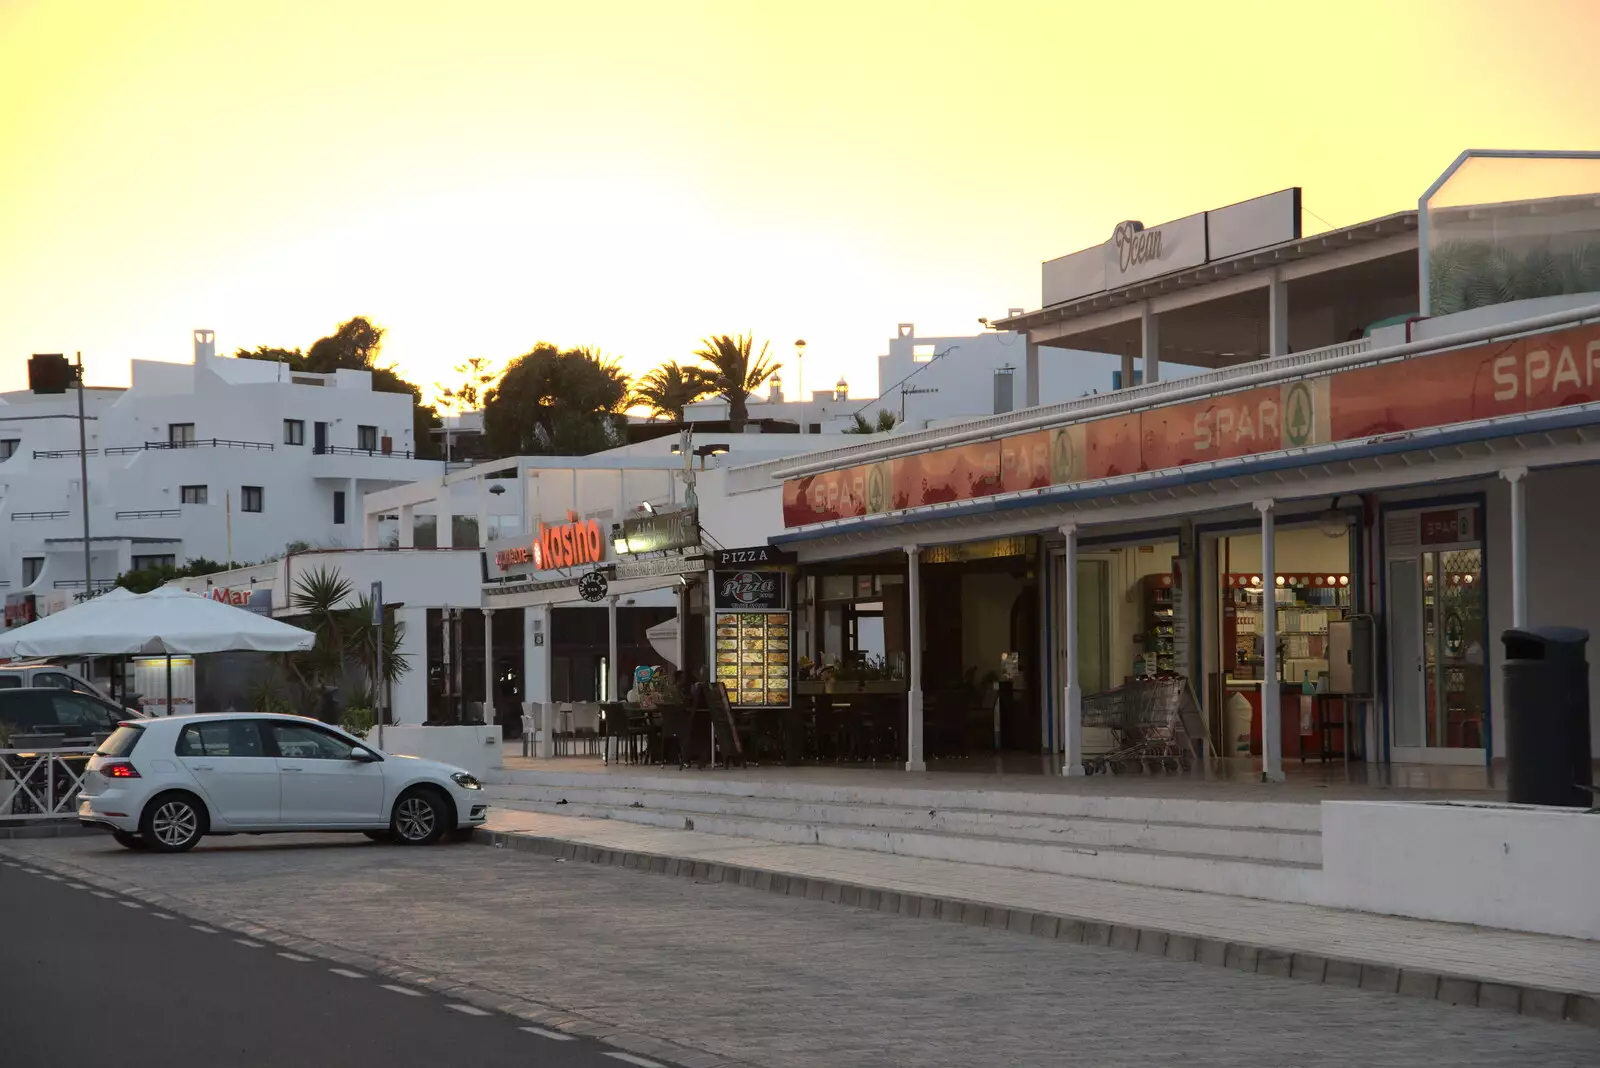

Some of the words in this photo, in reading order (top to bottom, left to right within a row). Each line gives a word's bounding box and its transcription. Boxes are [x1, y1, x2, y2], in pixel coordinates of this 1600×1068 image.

[1116, 222, 1162, 274] Ocean
[1194, 400, 1279, 450] SPAR
[984, 442, 1048, 485] SPAR
[815, 477, 865, 513] SPAR
[540, 509, 602, 570] kasino
[1427, 520, 1457, 536] SPAR
[721, 550, 768, 564] PIZZA
[581, 573, 607, 591] PIZZA
[721, 579, 775, 597] Pizza
[212, 587, 252, 605] Mar
